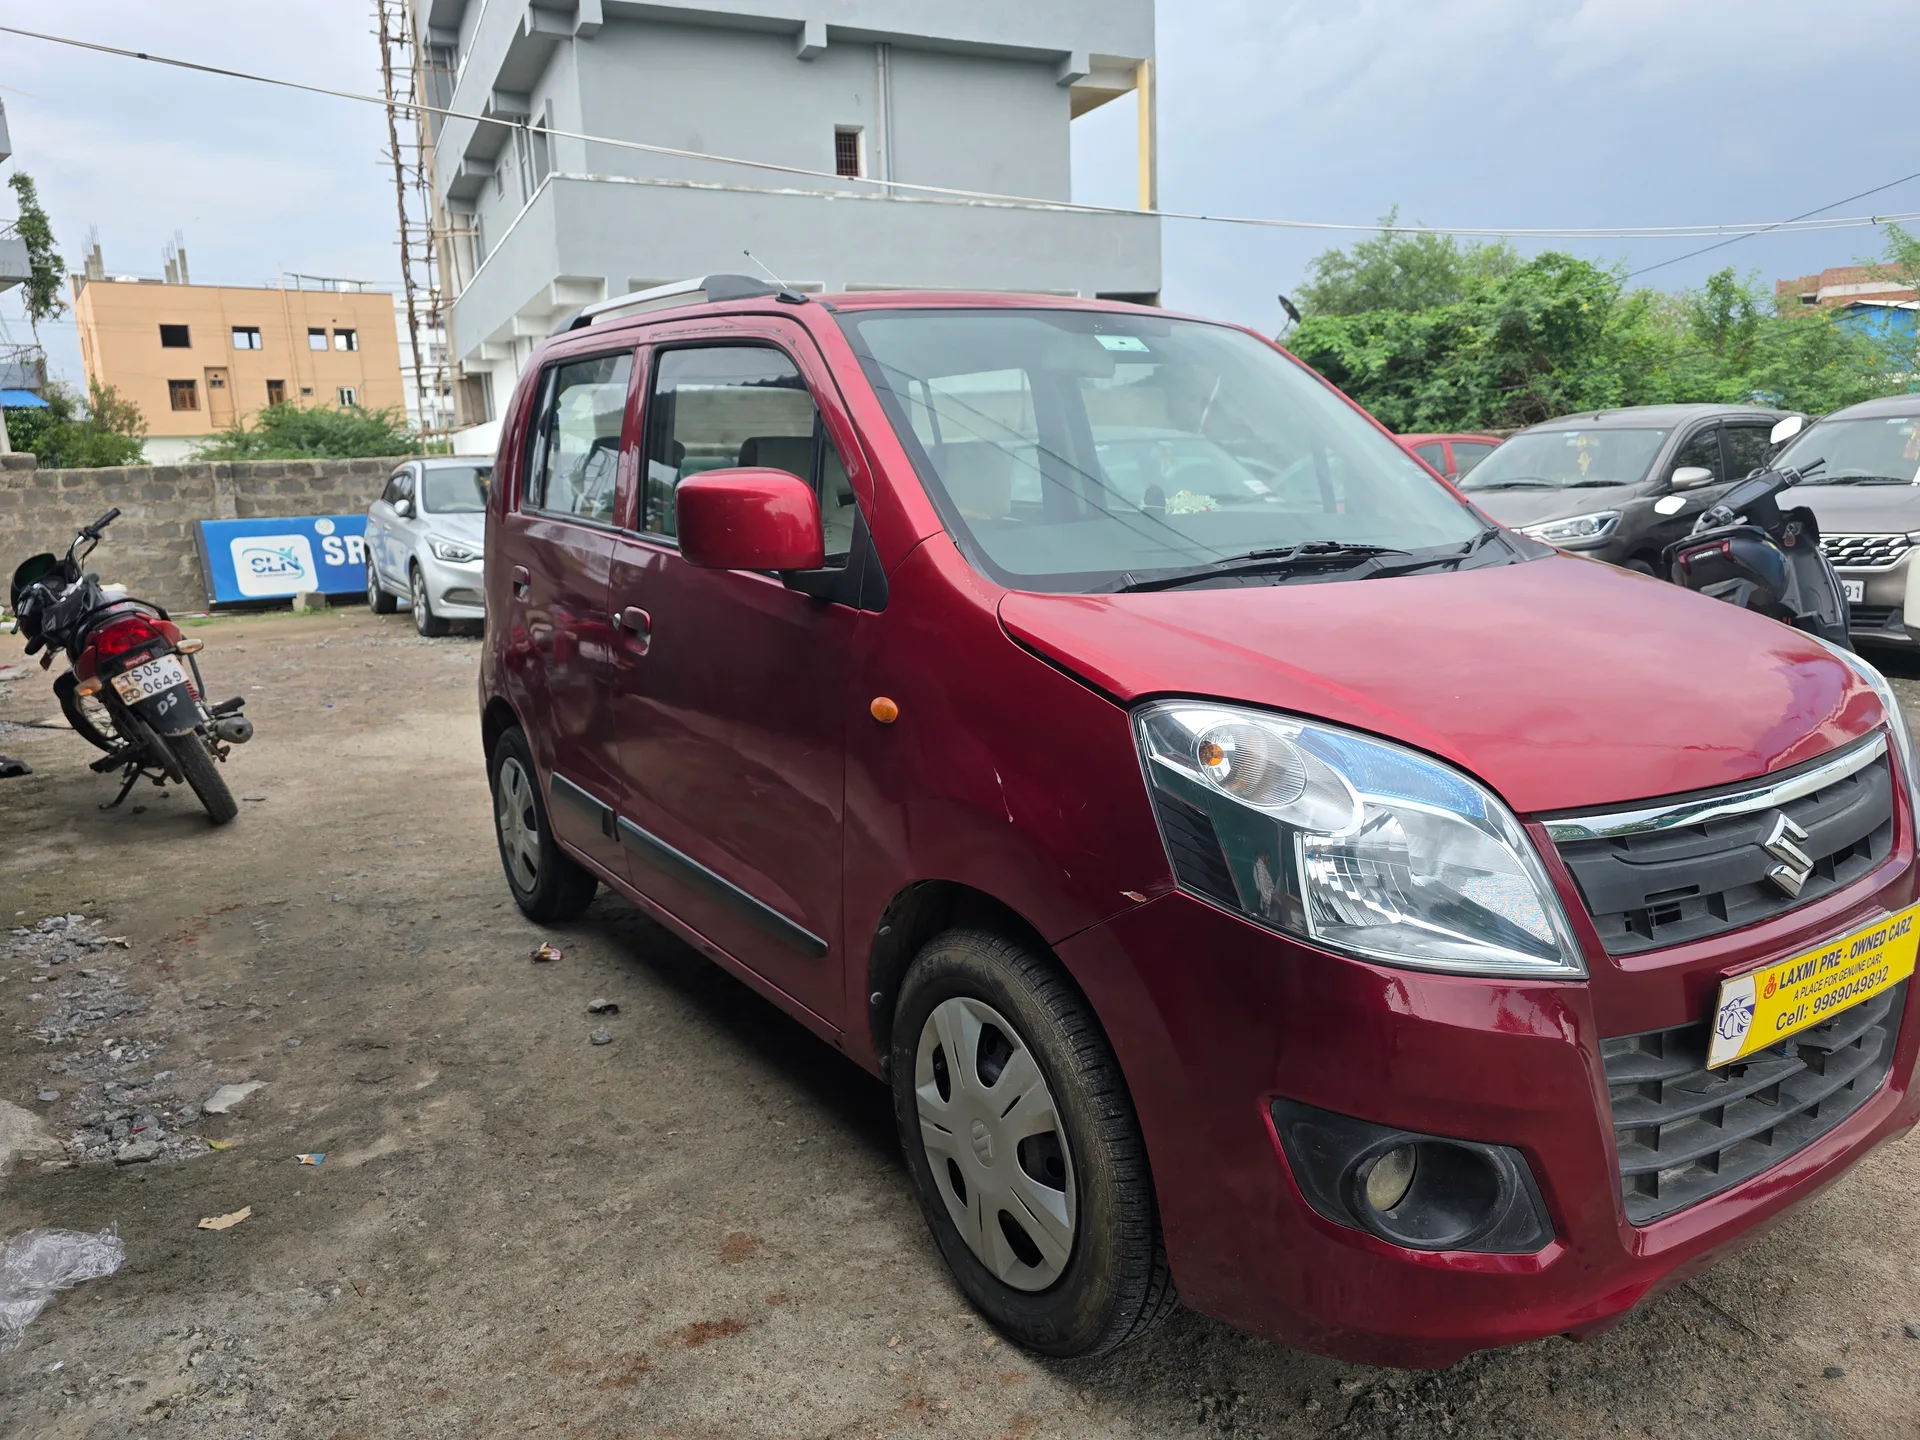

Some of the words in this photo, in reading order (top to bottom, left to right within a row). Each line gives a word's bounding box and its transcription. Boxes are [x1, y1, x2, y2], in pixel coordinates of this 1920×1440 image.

[143, 670, 182, 694] 0649
[157, 692, 178, 716] DS
[1779, 959, 1818, 990] LAXMI
[1819, 948, 1843, 973] PRE
[1850, 929, 1887, 959] OWNED
[1888, 916, 1913, 942] CARZ
[1776, 1003, 1809, 1031] Cell:
[1812, 965, 1889, 1015] 9989049892
[1793, 989, 1799, 1001] A
[1800, 978, 1823, 998] PLACE
[1824, 972, 1839, 988] FOR
[1839, 961, 1866, 981] GENUINE
